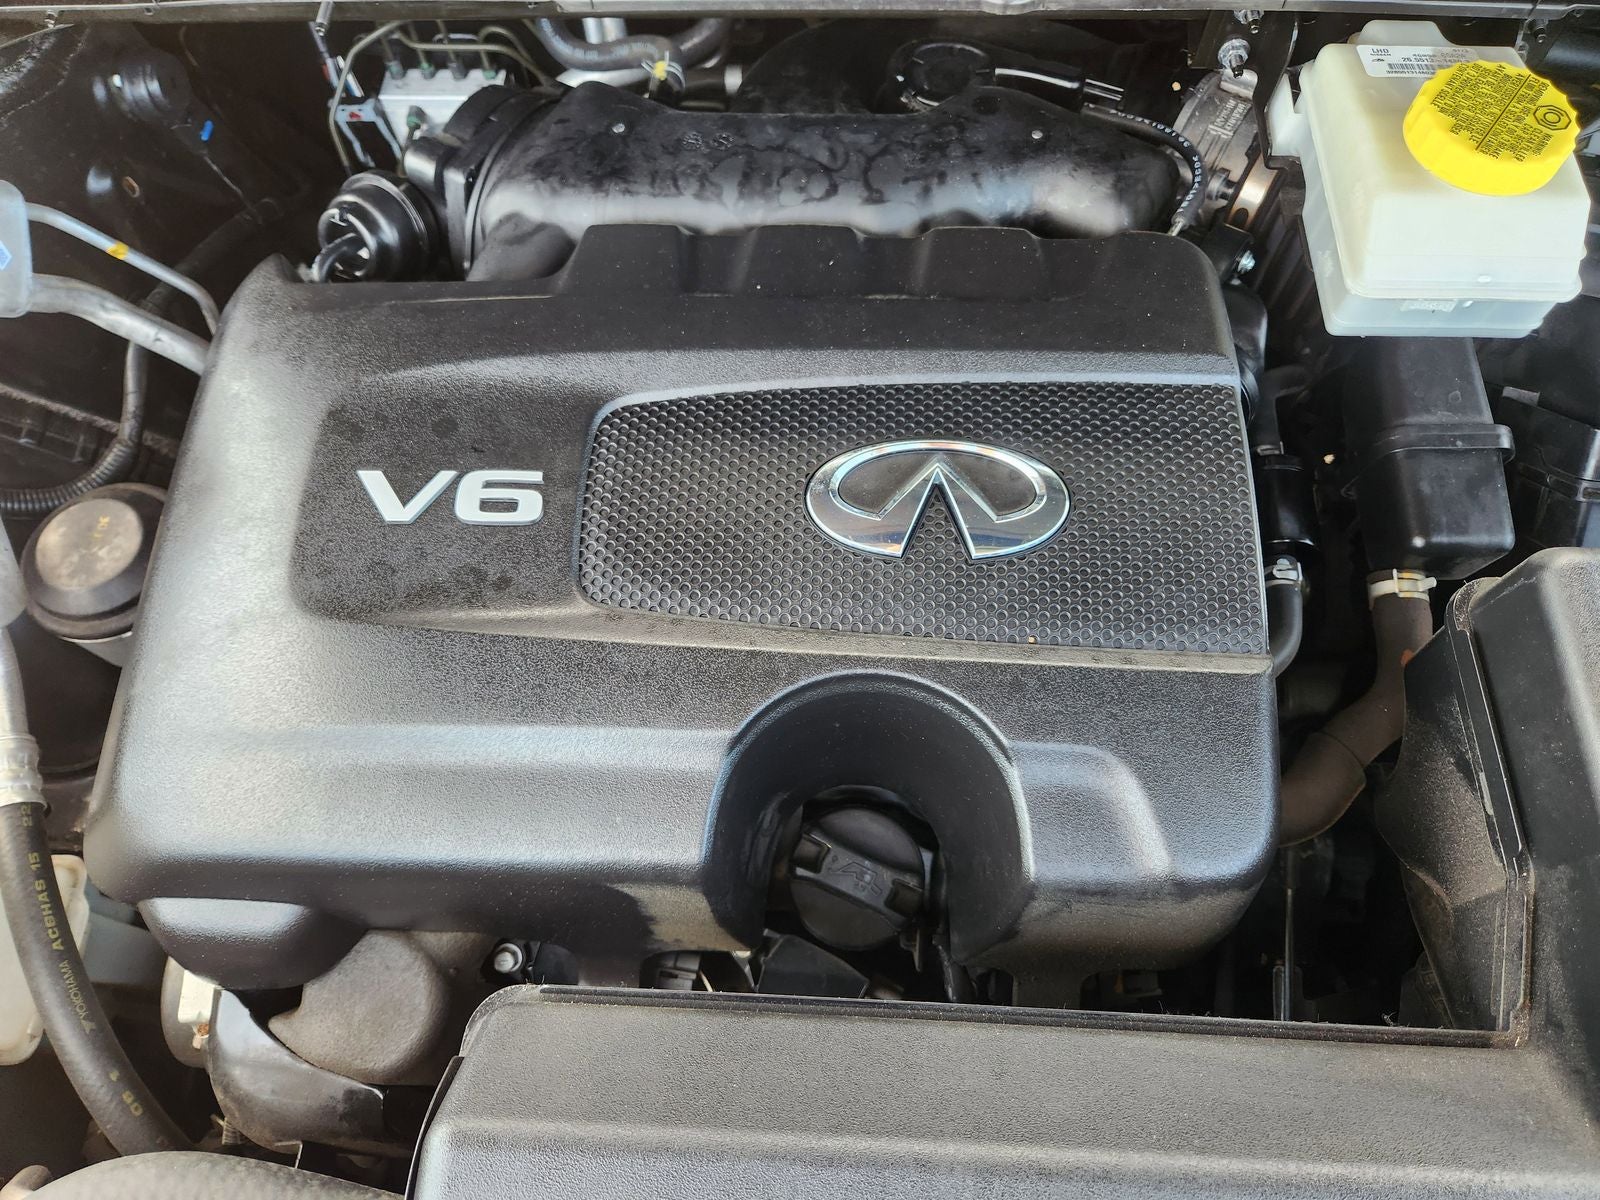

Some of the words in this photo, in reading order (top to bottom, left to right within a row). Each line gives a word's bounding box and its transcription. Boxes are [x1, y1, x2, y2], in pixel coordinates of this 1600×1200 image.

[1469, 62, 1482, 73] DOT
[1487, 63, 1506, 82] AVANT
[1482, 79, 1495, 88] DE
[1523, 76, 1540, 92] FLUID
[1485, 93, 1497, 102] DE
[1513, 90, 1530, 106] FROM
[1462, 99, 1493, 134] REMPLISSAGE
[1496, 108, 1517, 129] SEALED
[1518, 104, 1533, 116] USE
[1509, 113, 1526, 129] ONLY
[1518, 122, 1534, 135] CAP
[1468, 134, 1481, 144] LE
[1502, 126, 1517, 138] DOT
[1524, 127, 1544, 146] CLEAN
[1487, 139, 1508, 159] BRAKE
[1504, 133, 1526, 154] BEFORE
[1512, 143, 1532, 162] FILLER
[356, 470, 545, 525] V6
[27, 851, 41, 871] 15
[58, 959, 90, 1020] YOKOHAMA
